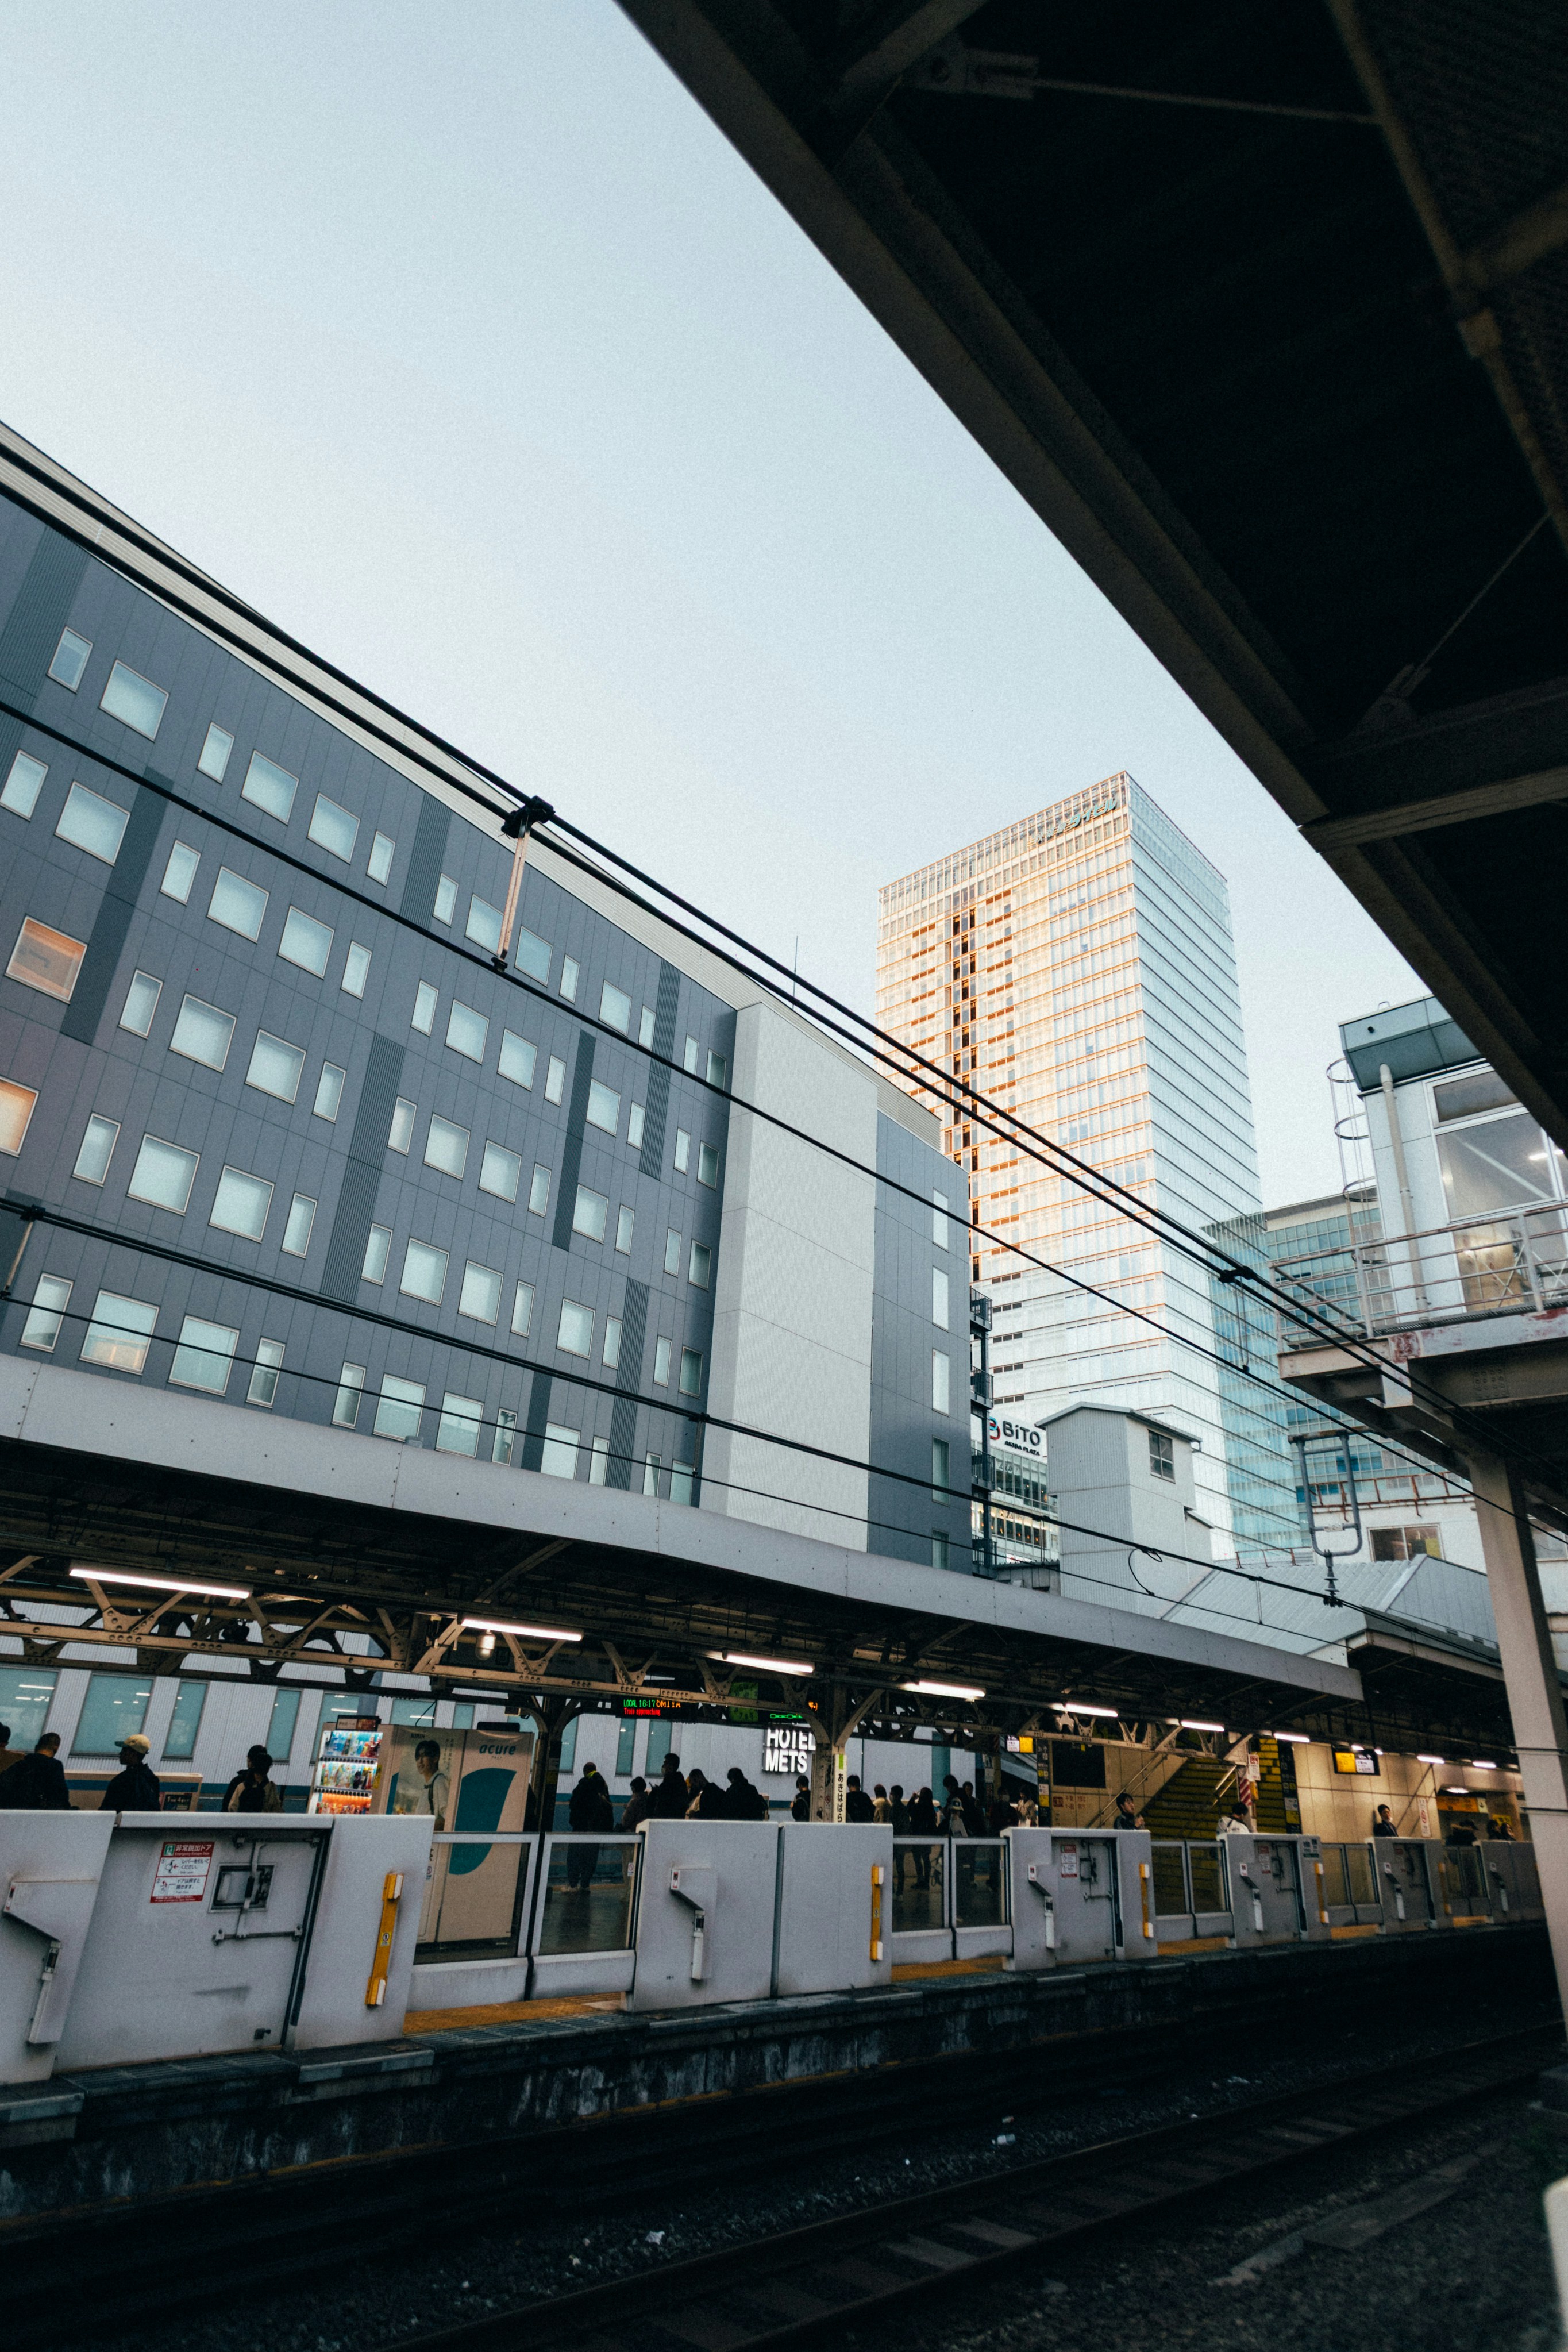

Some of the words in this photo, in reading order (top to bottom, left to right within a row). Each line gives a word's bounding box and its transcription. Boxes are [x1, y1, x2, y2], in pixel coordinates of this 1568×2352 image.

[1023, 1446, 1040, 1456] PLAZA
[623, 1699, 637, 1707] LOCAL
[656, 1700, 681, 1708] OMIYA
[766, 1727, 816, 1751] HOTEL
[479, 1743, 517, 1756] acure
[765, 1747, 807, 1773] METS
